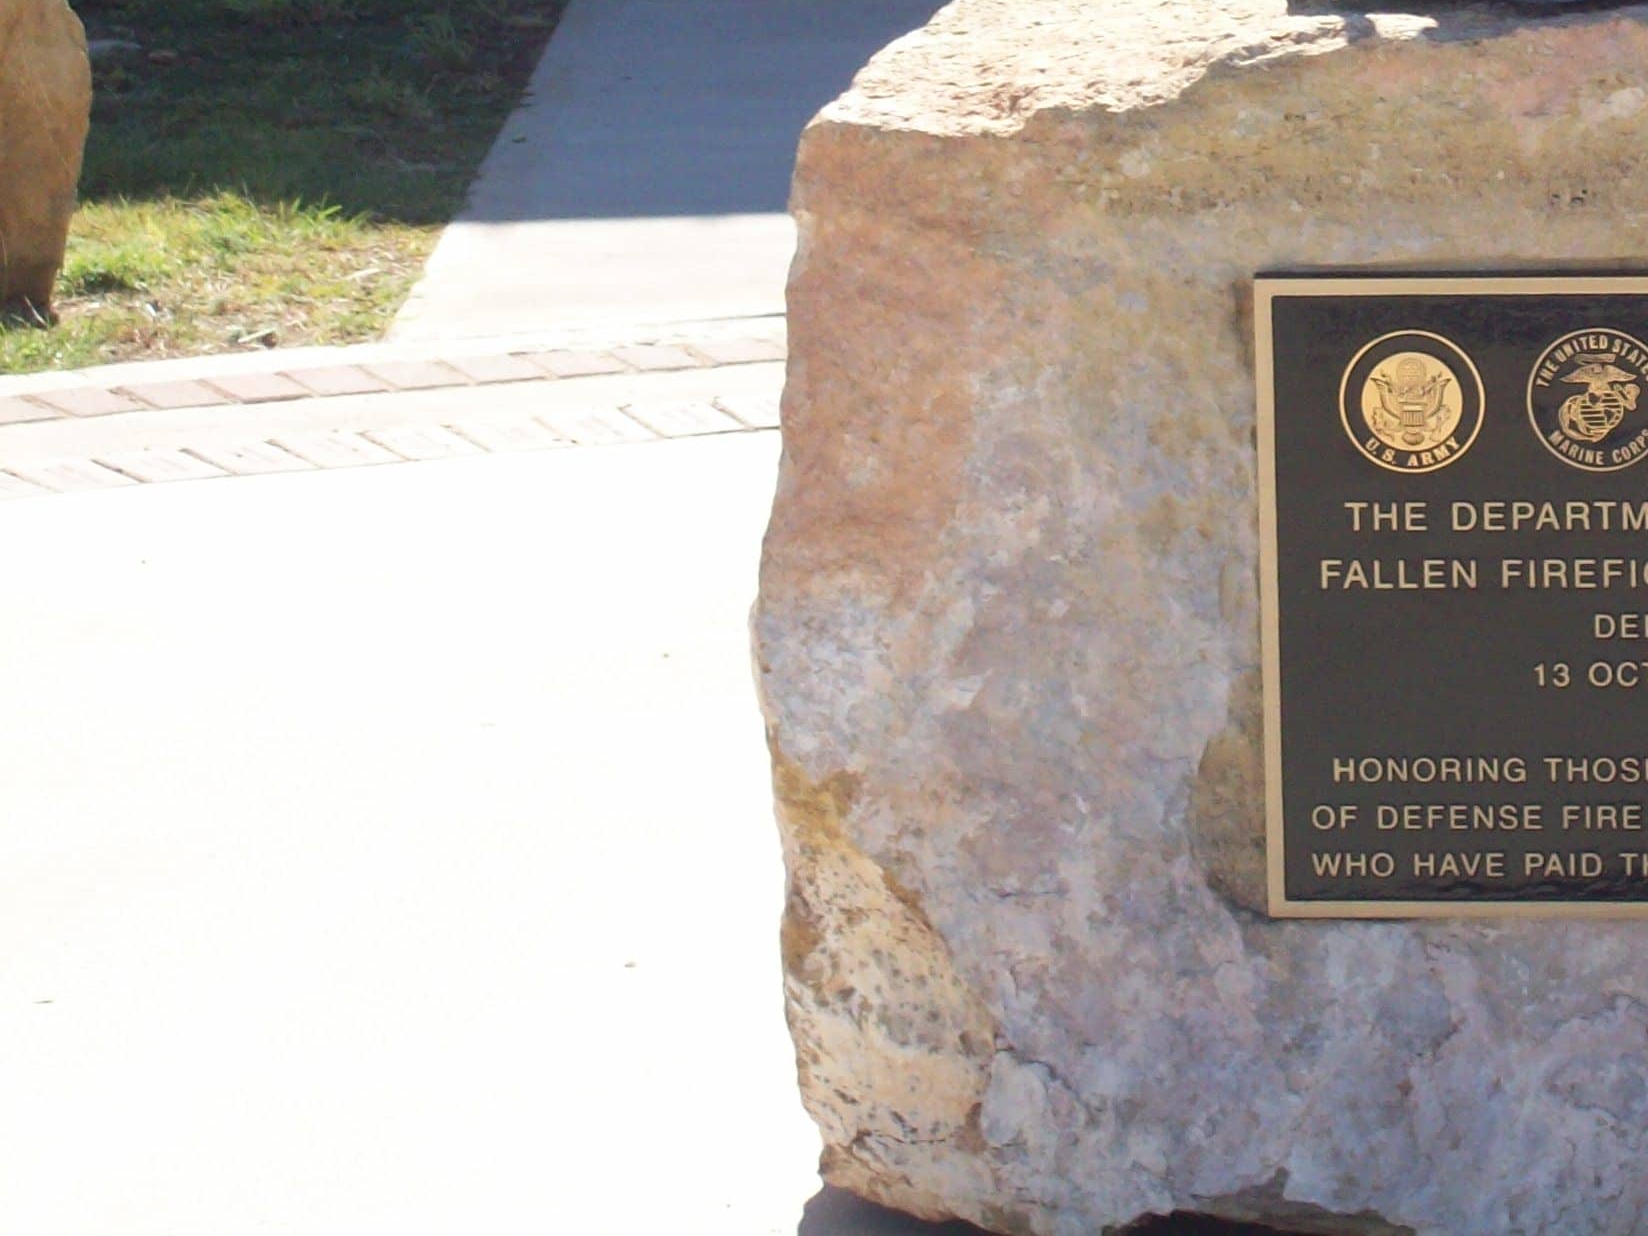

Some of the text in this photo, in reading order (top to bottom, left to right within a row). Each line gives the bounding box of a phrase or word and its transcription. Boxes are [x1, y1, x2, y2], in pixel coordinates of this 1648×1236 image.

[1536, 359, 1560, 387] THE
[1555, 335, 1608, 363] UNITED
[1365, 436, 1460, 467] U.S. ARMY
[1549, 429, 1604, 465] MARINE
[1343, 501, 1428, 532] THE
[1320, 559, 1477, 590] FALLEN
[1533, 662, 1571, 688] 13
[1333, 757, 1527, 783] HONORING
[1311, 805, 1358, 830] OF
[1377, 804, 1543, 830] DEFENSE
[1562, 805, 1641, 830] FIRE
[1311, 852, 1395, 878] WHO
[1413, 852, 1504, 877] HAVE
[1524, 852, 1603, 877] PAID
